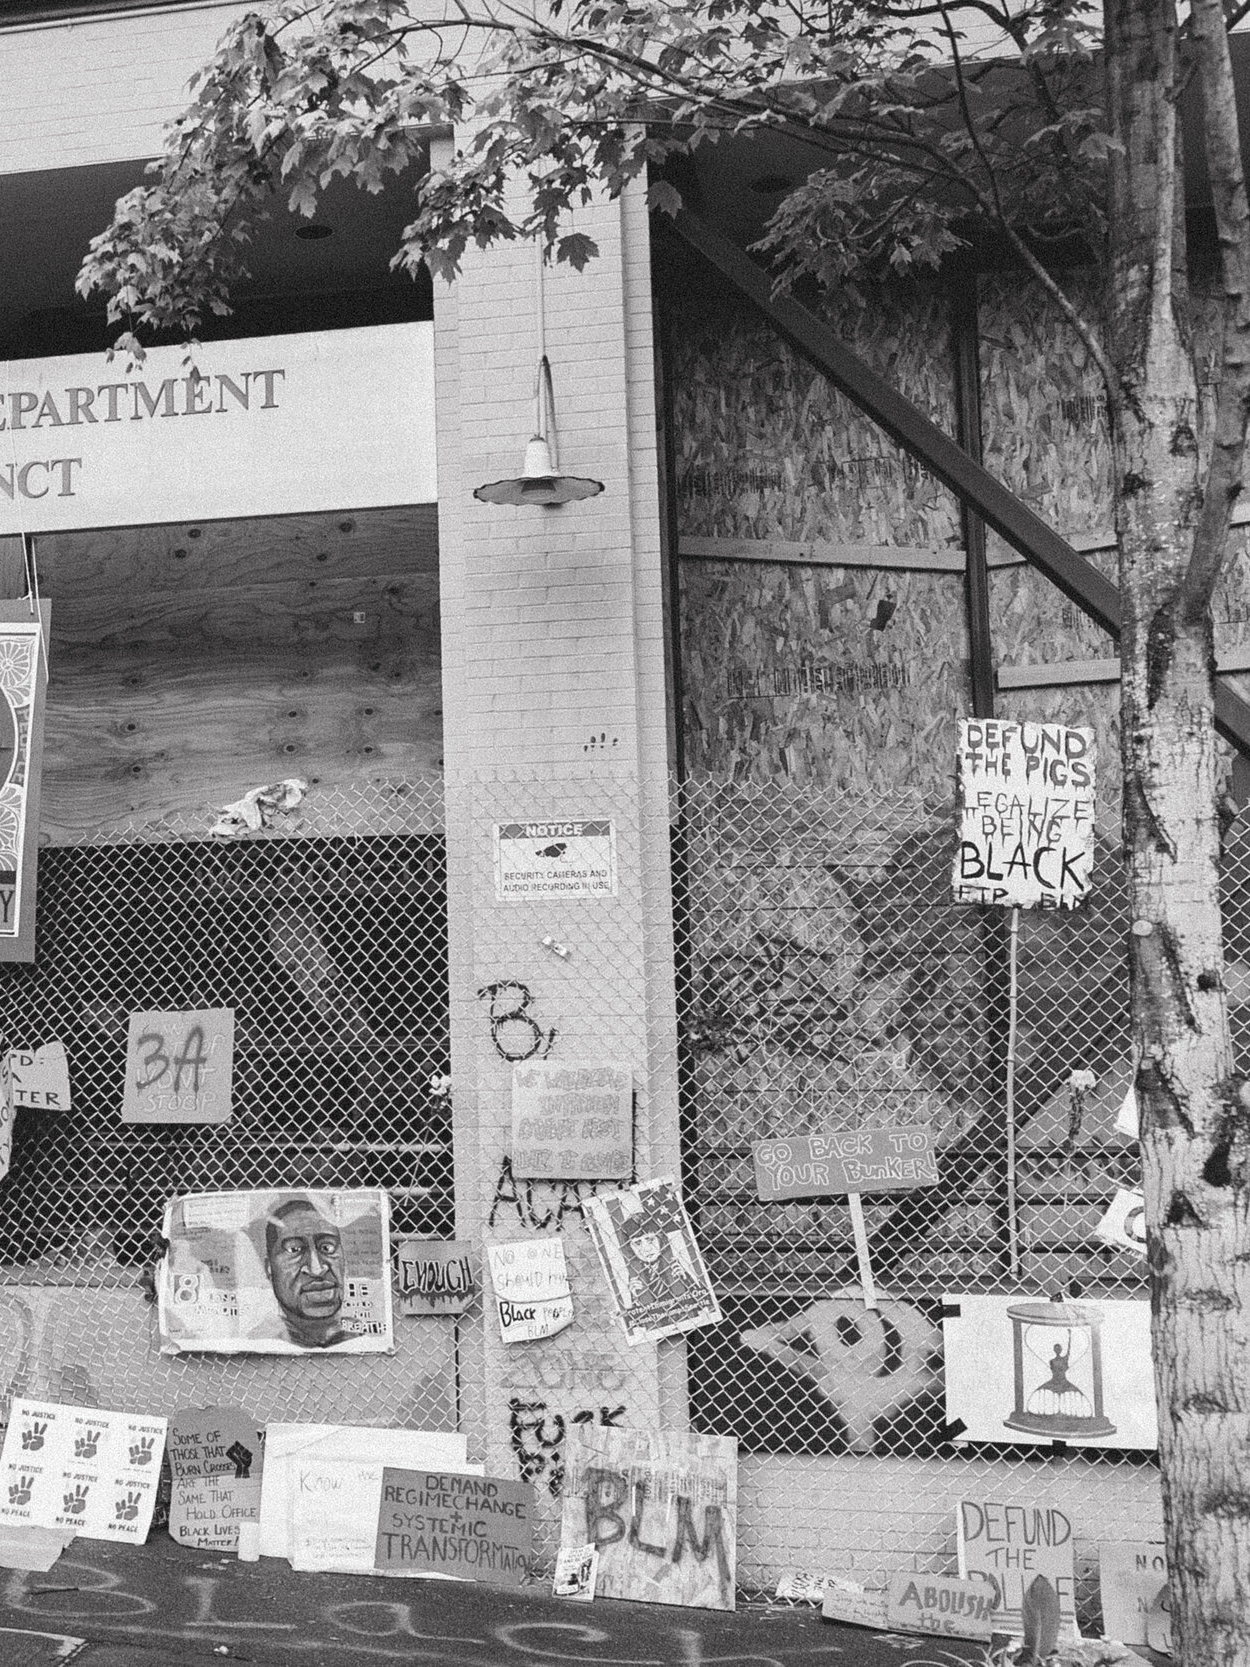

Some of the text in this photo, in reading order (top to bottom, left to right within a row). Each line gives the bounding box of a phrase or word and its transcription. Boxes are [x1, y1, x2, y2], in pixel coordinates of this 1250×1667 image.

[11, 709, 31, 784] PEOPLE
[968, 723, 1087, 759] DEFUND
[965, 752, 1091, 788] THE PIGS
[525, 824, 584, 836] NOTICE
[981, 812, 1062, 848] BEING
[961, 840, 1086, 891] BLACK
[504, 869, 608, 881] SECURITY CAMERAS AND
[503, 883, 529, 892] AUDIO
[531, 882, 581, 891] RECORDING
[592, 881, 610, 890] USE
[756, 1133, 928, 1166] GO BACK TO
[765, 1163, 829, 1191] YOUR
[174, 1273, 199, 1304] 8
[348, 1282, 369, 1298] HE
[32, 1411, 55, 1420] JUSTICE
[85, 1419, 109, 1428] JUSTICE
[139, 1426, 163, 1434] JUSTICE
[173, 1427, 221, 1445] SOME OF
[170, 1445, 226, 1461] THOSE THAT
[175, 1461, 202, 1477] BURN
[73, 1474, 98, 1482] JUSTICE
[126, 1481, 150, 1489] JUSTICE
[177, 1475, 220, 1490] ARE THE
[425, 1475, 498, 1497] DEMAND
[178, 1490, 234, 1505] SAME THAT
[12, 1509, 30, 1517] PEACE
[186, 1504, 257, 1520] HOLD OFFICE
[65, 1518, 86, 1526] PEACE
[392, 1513, 488, 1538] SYSTEMIC
[961, 1501, 1072, 1547] DEFUND
[180, 1524, 240, 1537] BLACK LIVES
[582, 1467, 732, 1595] BLM
[985, 1547, 1037, 1571] THE
